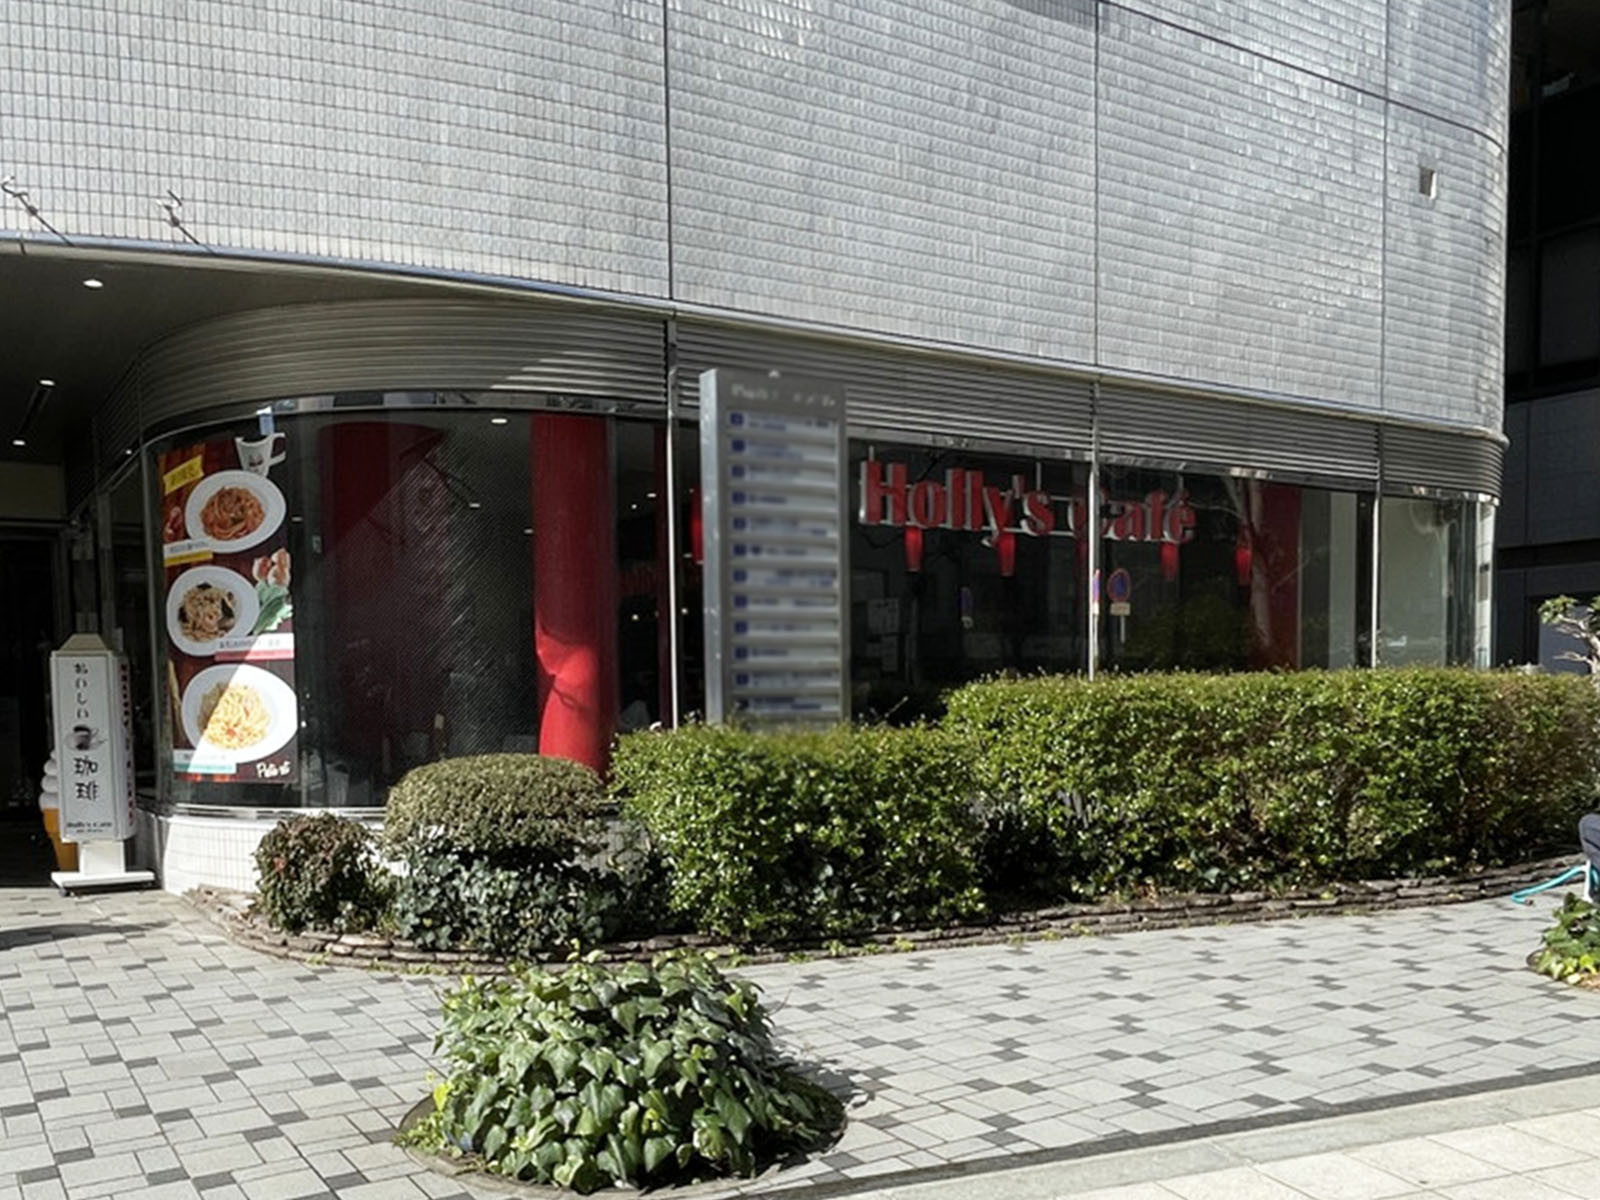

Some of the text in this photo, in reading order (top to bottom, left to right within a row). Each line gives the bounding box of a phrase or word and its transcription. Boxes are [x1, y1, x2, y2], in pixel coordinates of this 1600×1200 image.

[860, 460, 1054, 548] Holly's
[73, 663, 89, 718] おいしい
[73, 755, 99, 801] 珈琲
